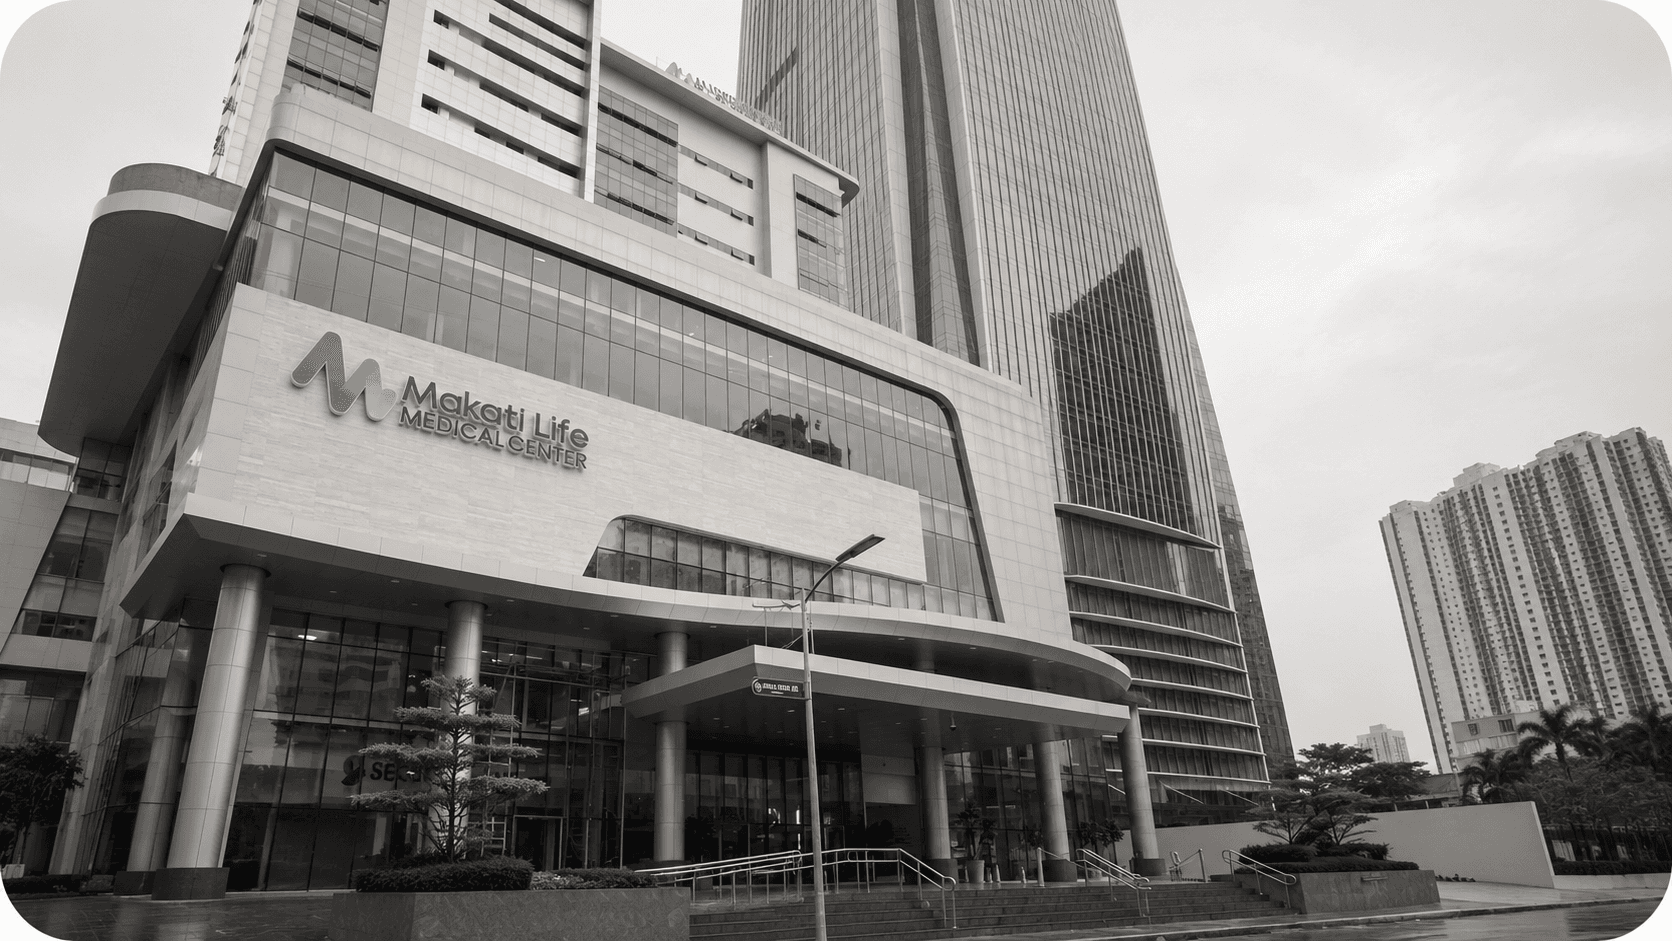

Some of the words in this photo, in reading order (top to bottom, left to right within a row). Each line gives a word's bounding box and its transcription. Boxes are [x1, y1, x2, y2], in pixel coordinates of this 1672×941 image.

[399, 405, 505, 448] MEDICAL
[508, 435, 588, 470] CENTER
[402, 375, 525, 433] Makati
[534, 412, 590, 449] Life
